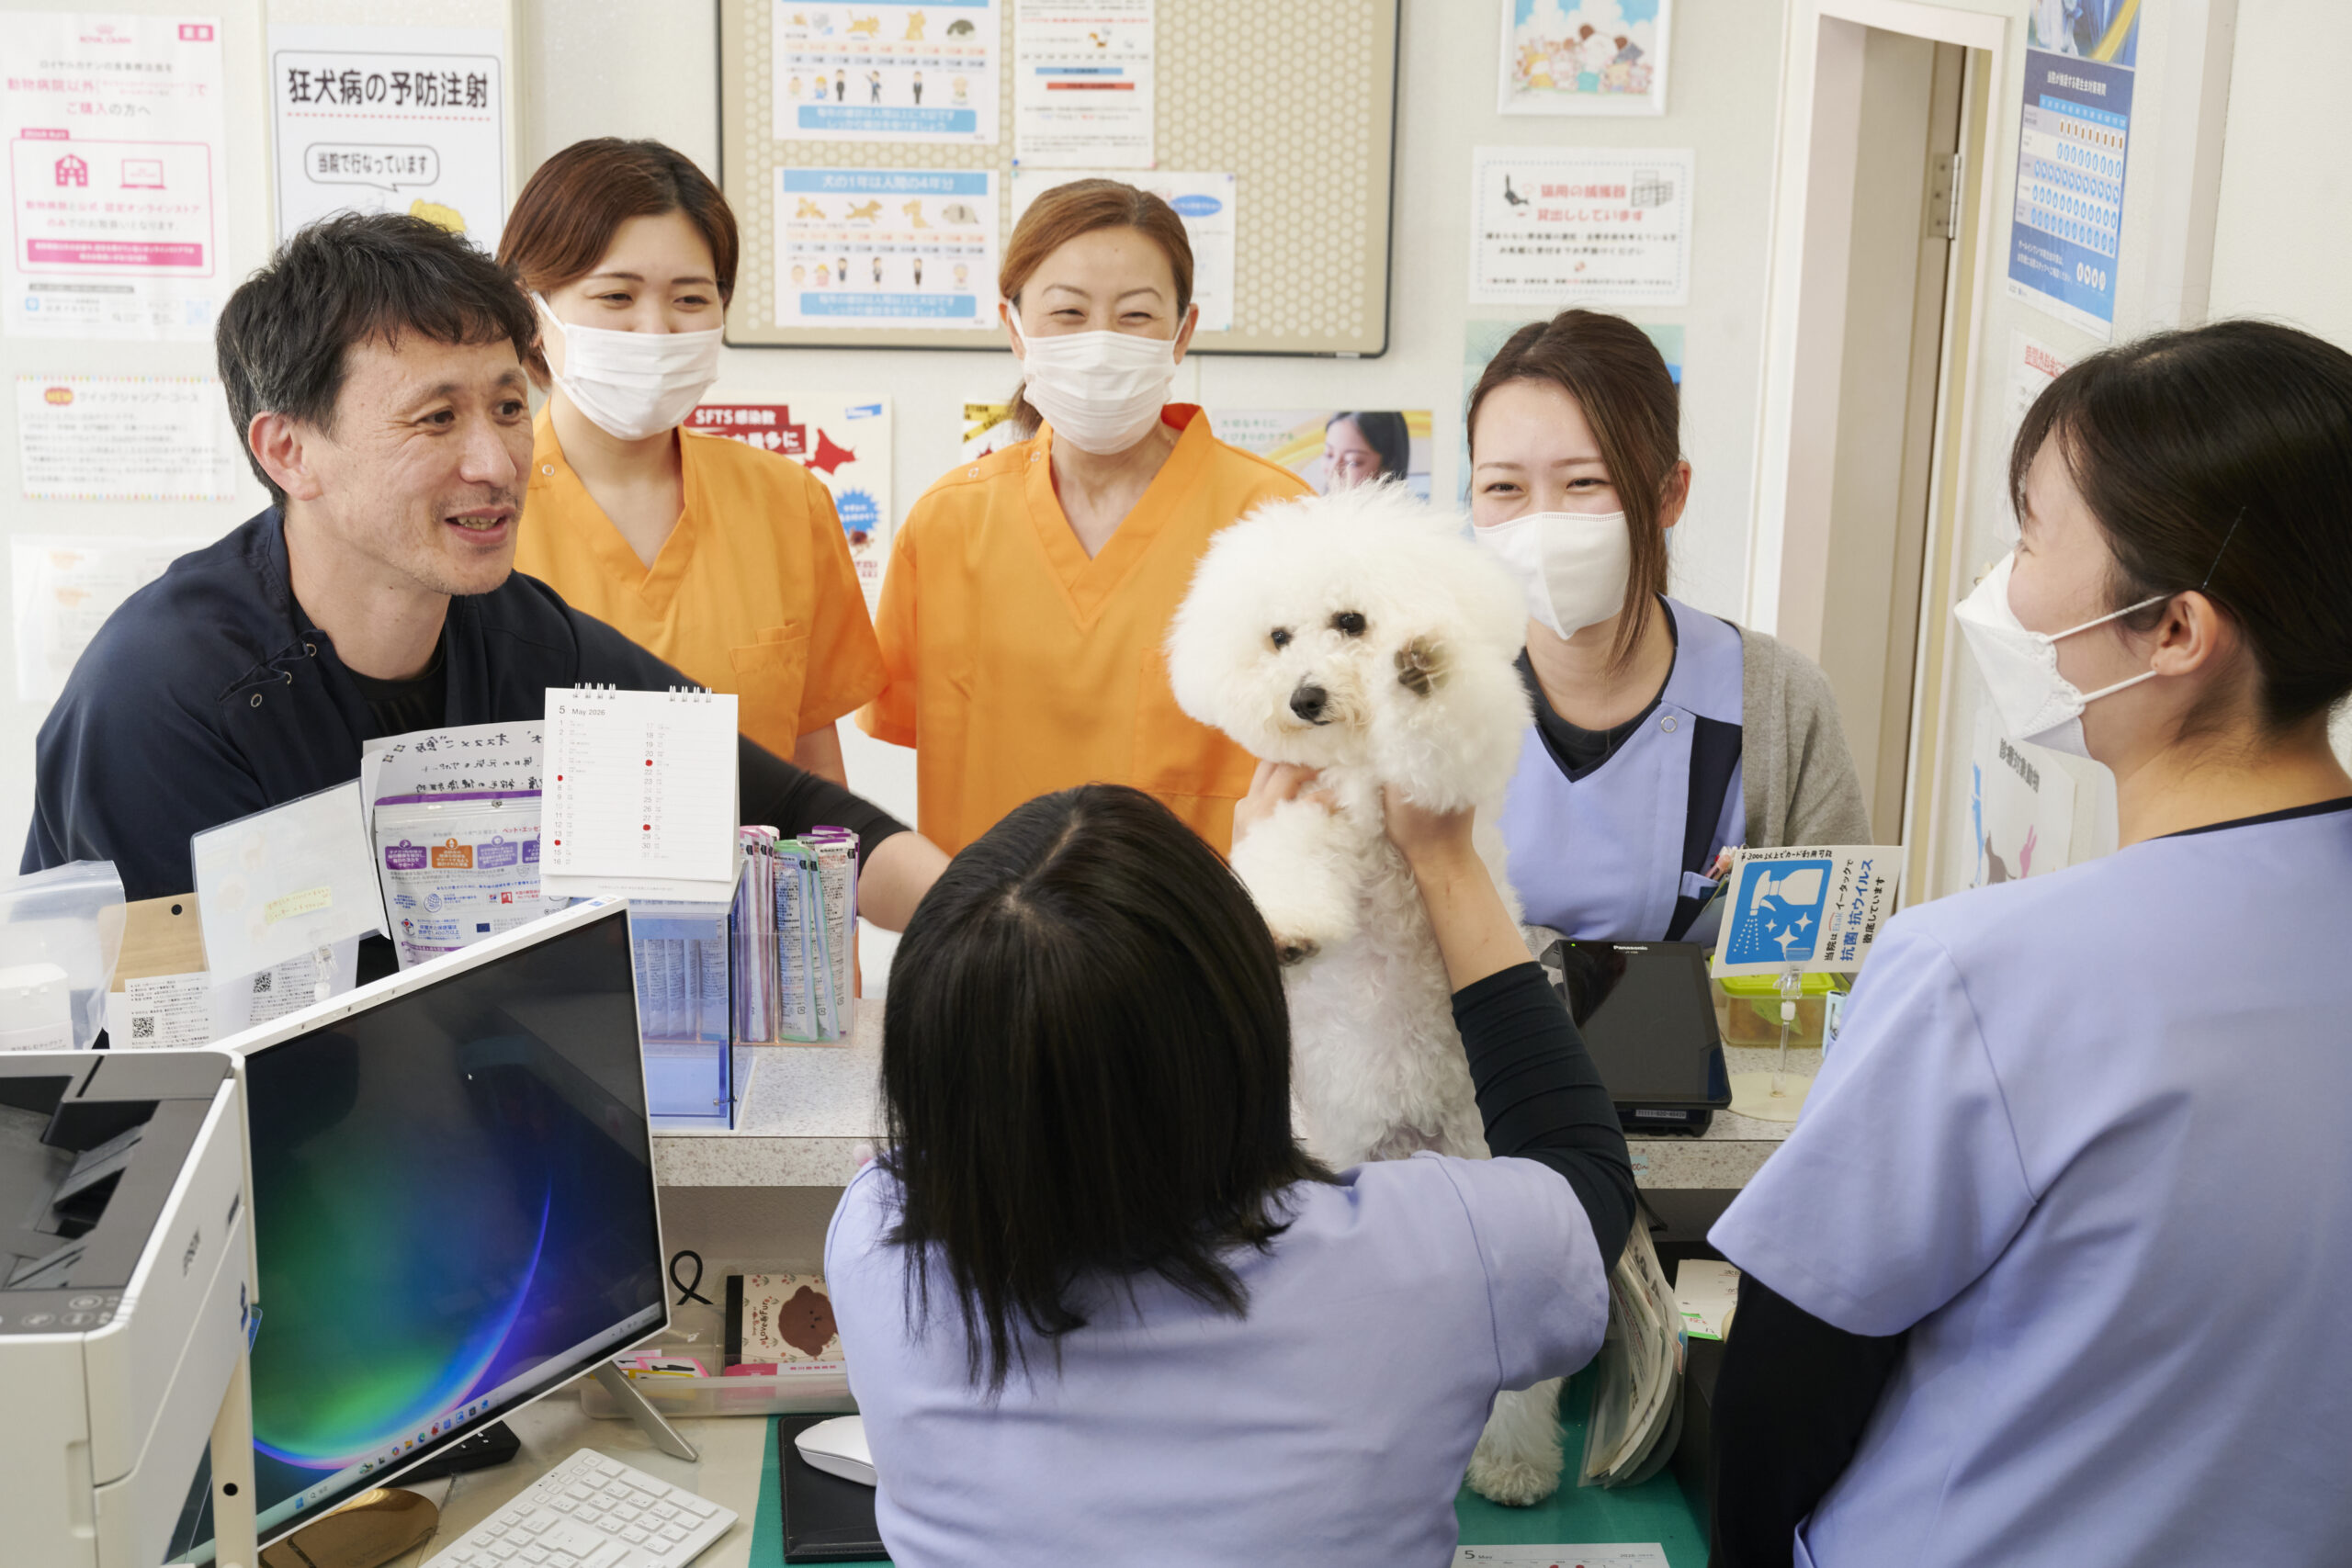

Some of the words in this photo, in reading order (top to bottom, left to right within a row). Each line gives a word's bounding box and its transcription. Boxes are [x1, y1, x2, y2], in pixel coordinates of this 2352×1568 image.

[288, 68, 488, 108] 狂犬病の予防注射
[318, 152, 428, 175] 当院で行なっています
[560, 705, 566, 714] 5
[1824, 933, 1838, 962] 当院は
[1836, 859, 1854, 911] イータックで
[1840, 858, 1874, 962] 抗菌・抗ウイルス
[1862, 875, 1886, 944] 徹底しています
[1464, 1551, 1475, 1559] 5
